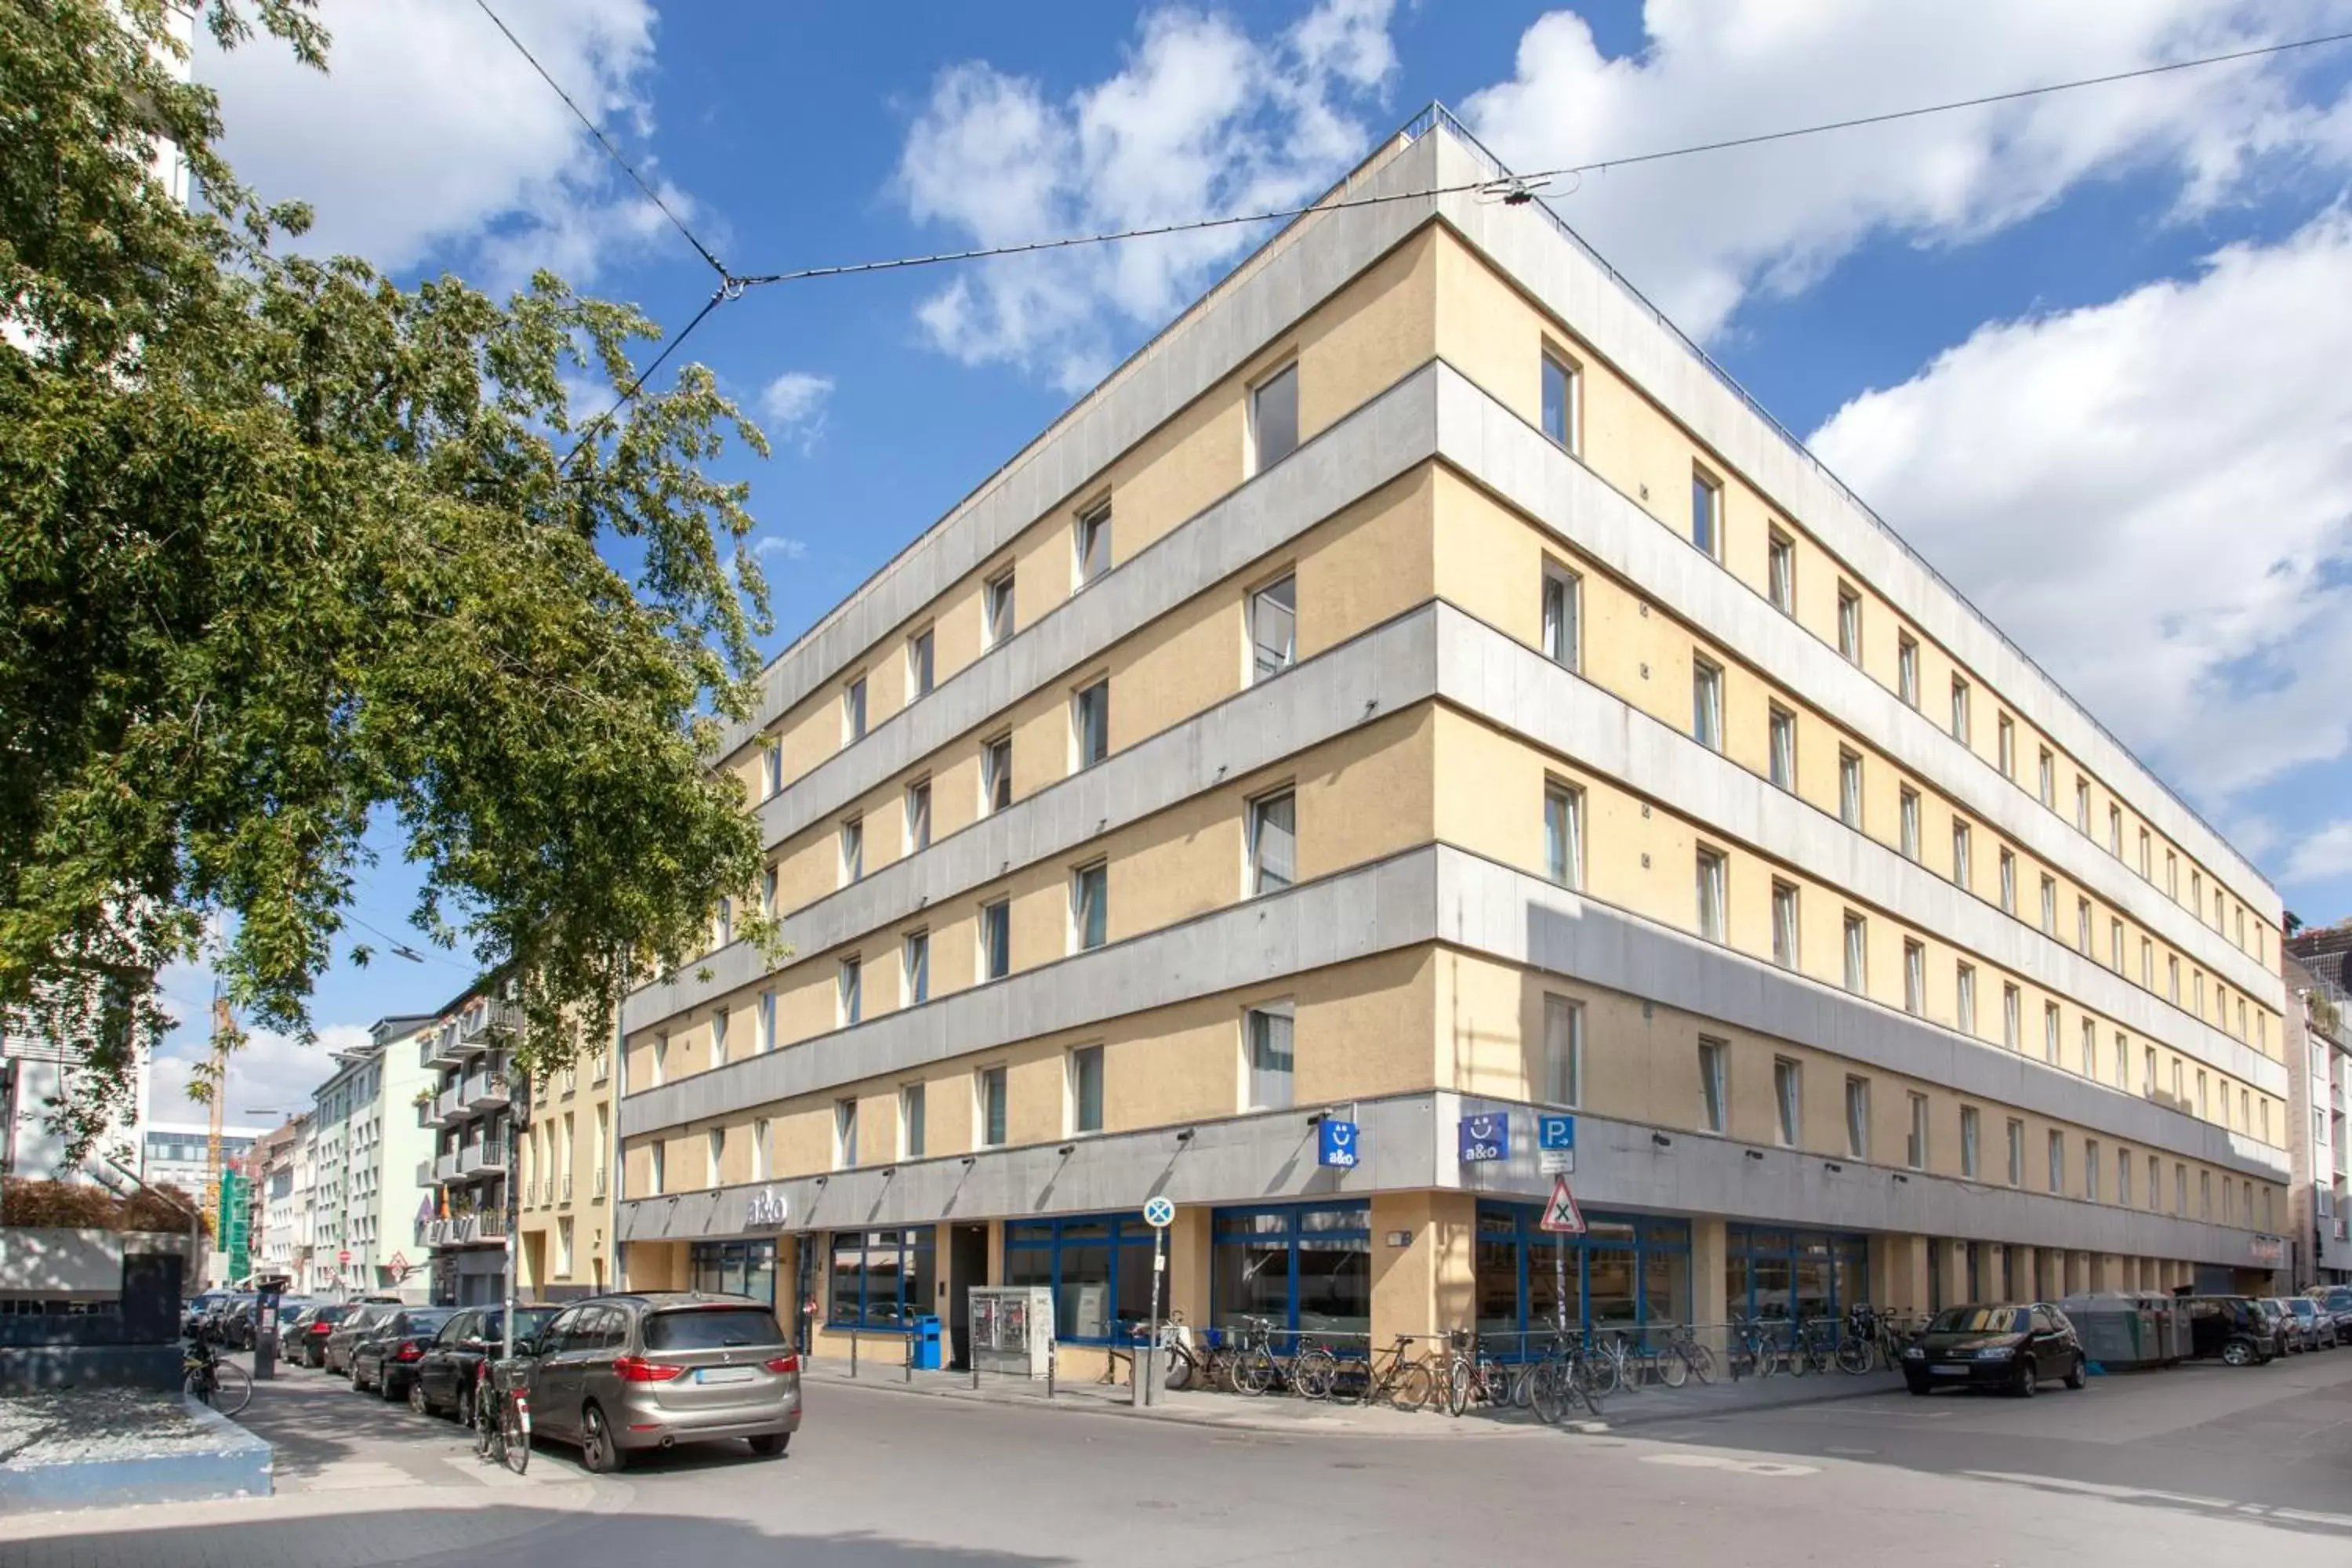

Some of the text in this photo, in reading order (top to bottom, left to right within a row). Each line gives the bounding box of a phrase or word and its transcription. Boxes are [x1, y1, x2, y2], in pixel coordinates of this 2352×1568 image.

[1548, 1120, 1566, 1146] P
[1329, 1149, 1354, 1165] a&o
[1465, 1143, 1497, 1160] a&o
